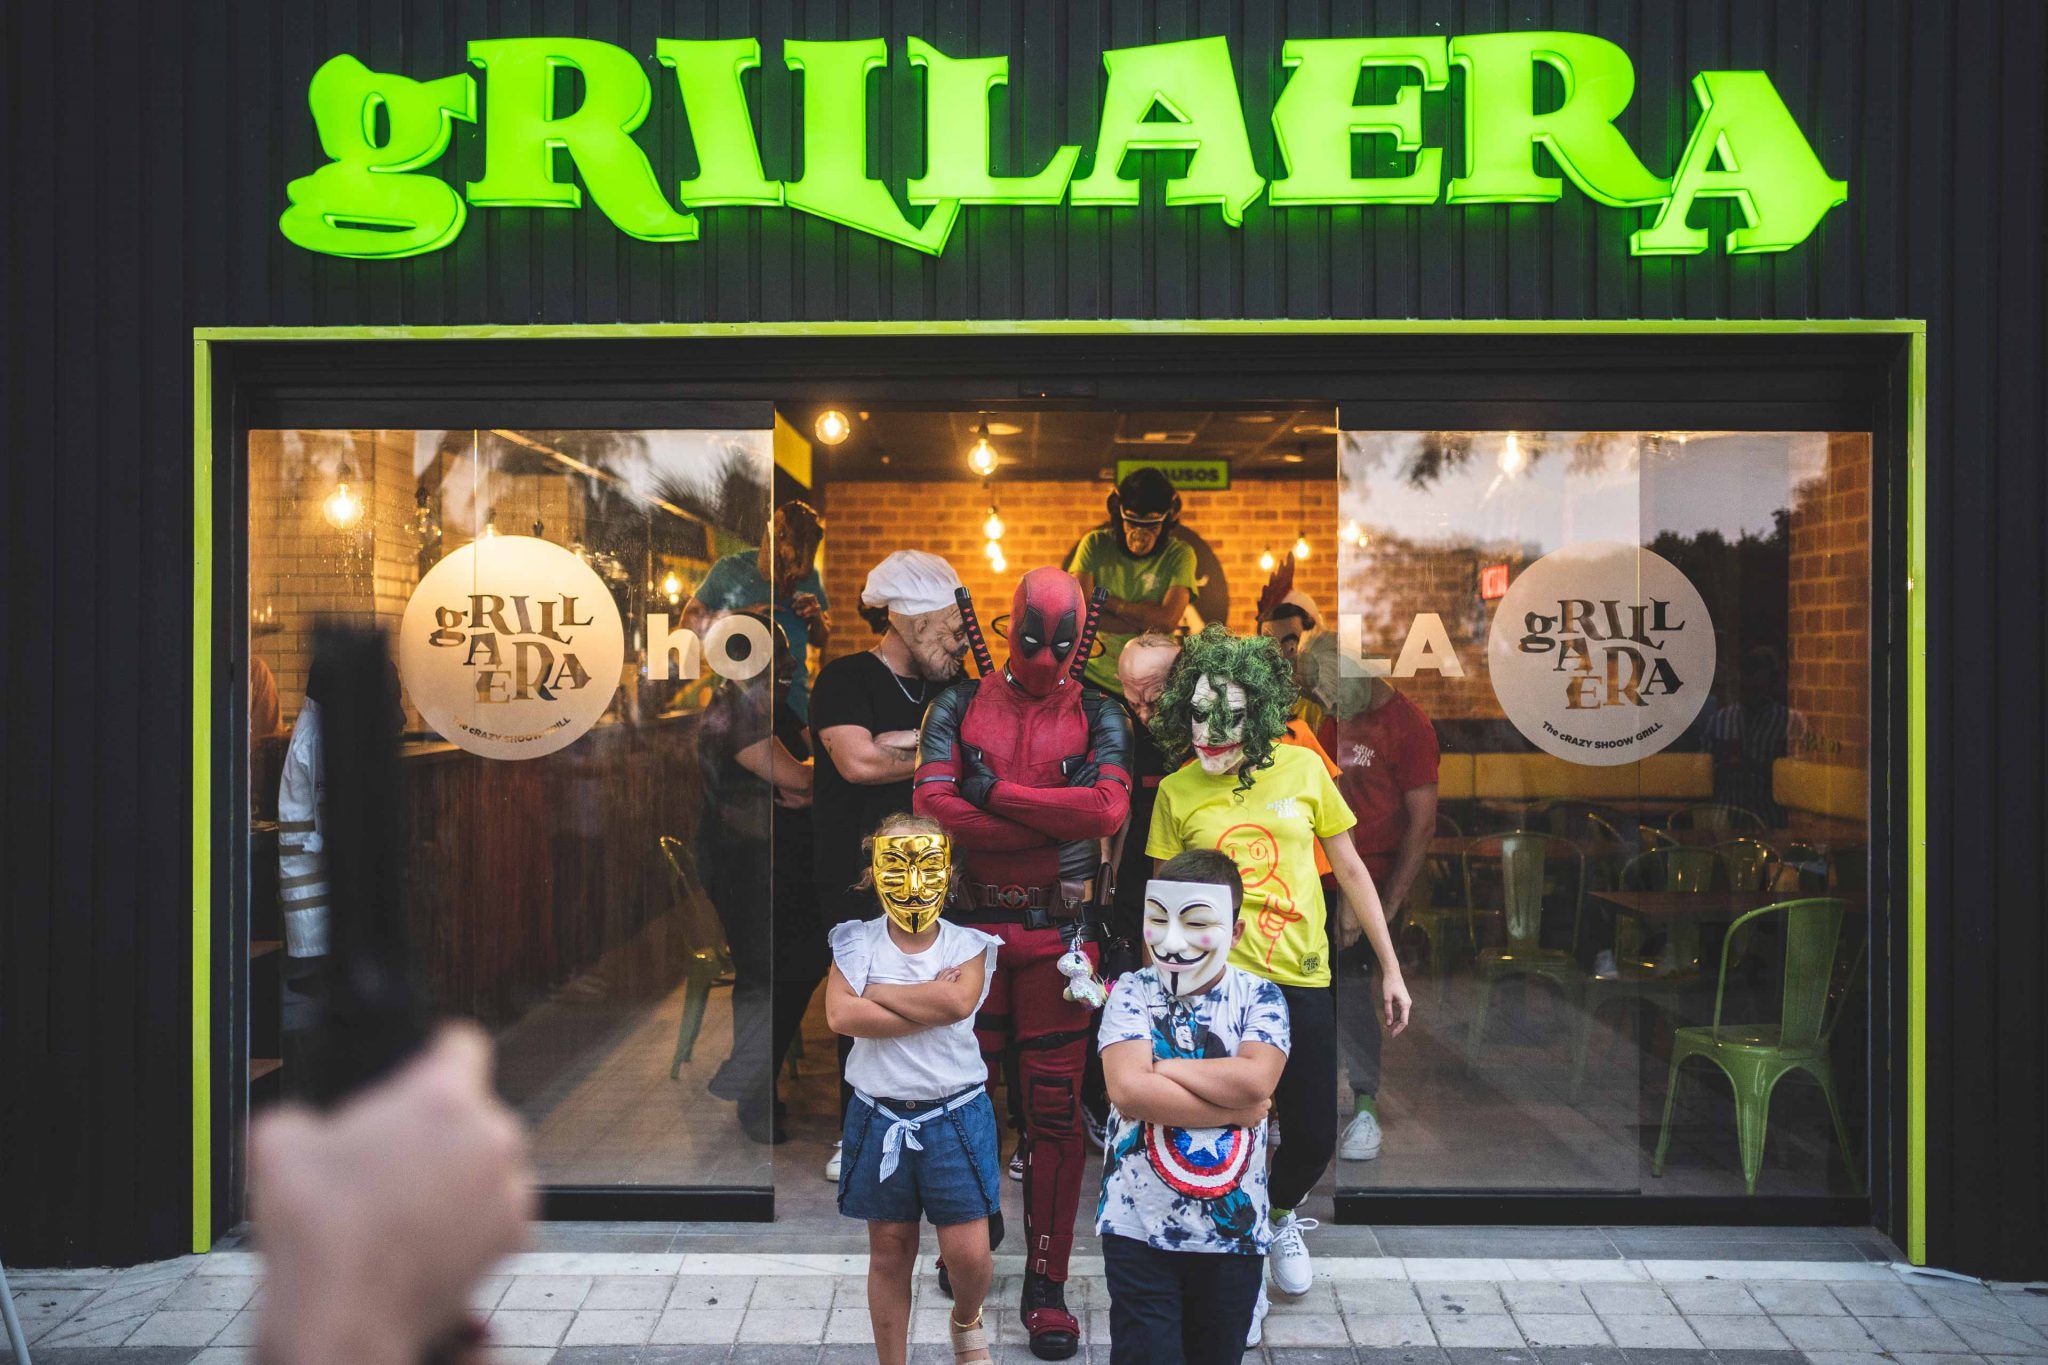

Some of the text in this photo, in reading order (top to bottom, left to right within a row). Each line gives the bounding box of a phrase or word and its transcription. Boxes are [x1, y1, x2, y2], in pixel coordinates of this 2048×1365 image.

[1339, 613, 1465, 678] LA
[1543, 721, 1559, 737] The
[1594, 736, 1633, 748] SHOOW
[1636, 722, 1663, 741] GRILL
